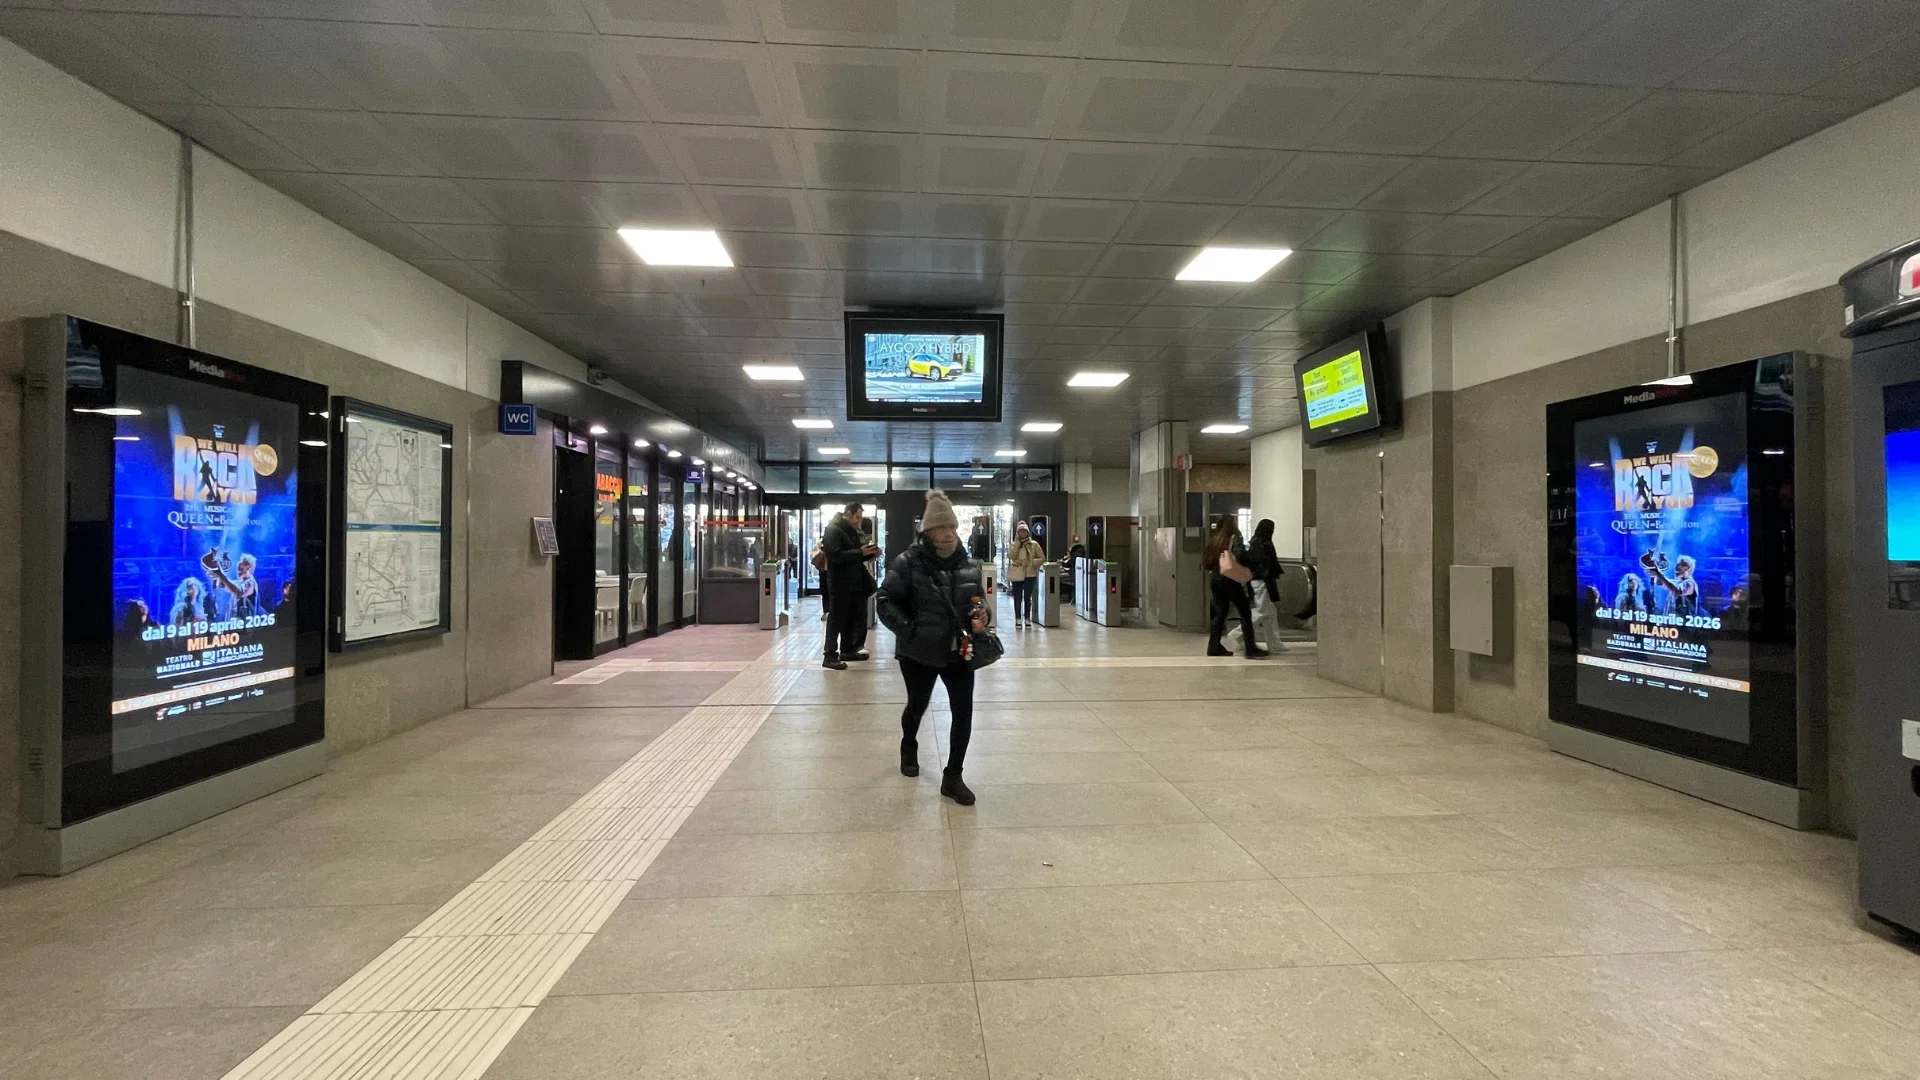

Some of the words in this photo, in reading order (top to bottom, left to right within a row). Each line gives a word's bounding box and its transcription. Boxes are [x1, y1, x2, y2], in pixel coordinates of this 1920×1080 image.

[879, 343, 914, 353] AYGO
[918, 343, 926, 352] X
[928, 343, 971, 353] HYBRID
[507, 413, 529, 423] WC
[198, 439, 213, 450] WE
[216, 441, 238, 453] WILL
[1633, 457, 1647, 466] WE
[1649, 454, 1671, 464] WILL
[168, 511, 214, 529] QUEEN
[1611, 520, 1650, 534] QUEEN
[1596, 607, 1611, 618] dal
[1614, 609, 1621, 620] 9
[1623, 610, 1633, 621] al
[1635, 611, 1647, 622] 19
[1650, 613, 1683, 626] aprile
[1685, 616, 1721, 629] 2026
[142, 627, 165, 641] dal
[167, 625, 176, 638] 9
[179, 622, 191, 636] al
[193, 621, 208, 634] 19
[210, 618, 244, 634] aprile
[245, 614, 275, 628] 2026
[1630, 624, 1679, 638] MILANO
[187, 633, 240, 651] MILANO
[1607, 639, 1641, 649] NAZIONALE
[1612, 634, 1635, 642] TEATRO
[216, 644, 263, 657] ITALIANA
[1656, 640, 1706, 652] ITALIANA
[216, 651, 263, 663] ASSICURAZIONI
[1656, 647, 1706, 658] ASSICURAZIONI
[165, 655, 193, 664] TEATRO
[157, 661, 200, 674] NAZIONALE
